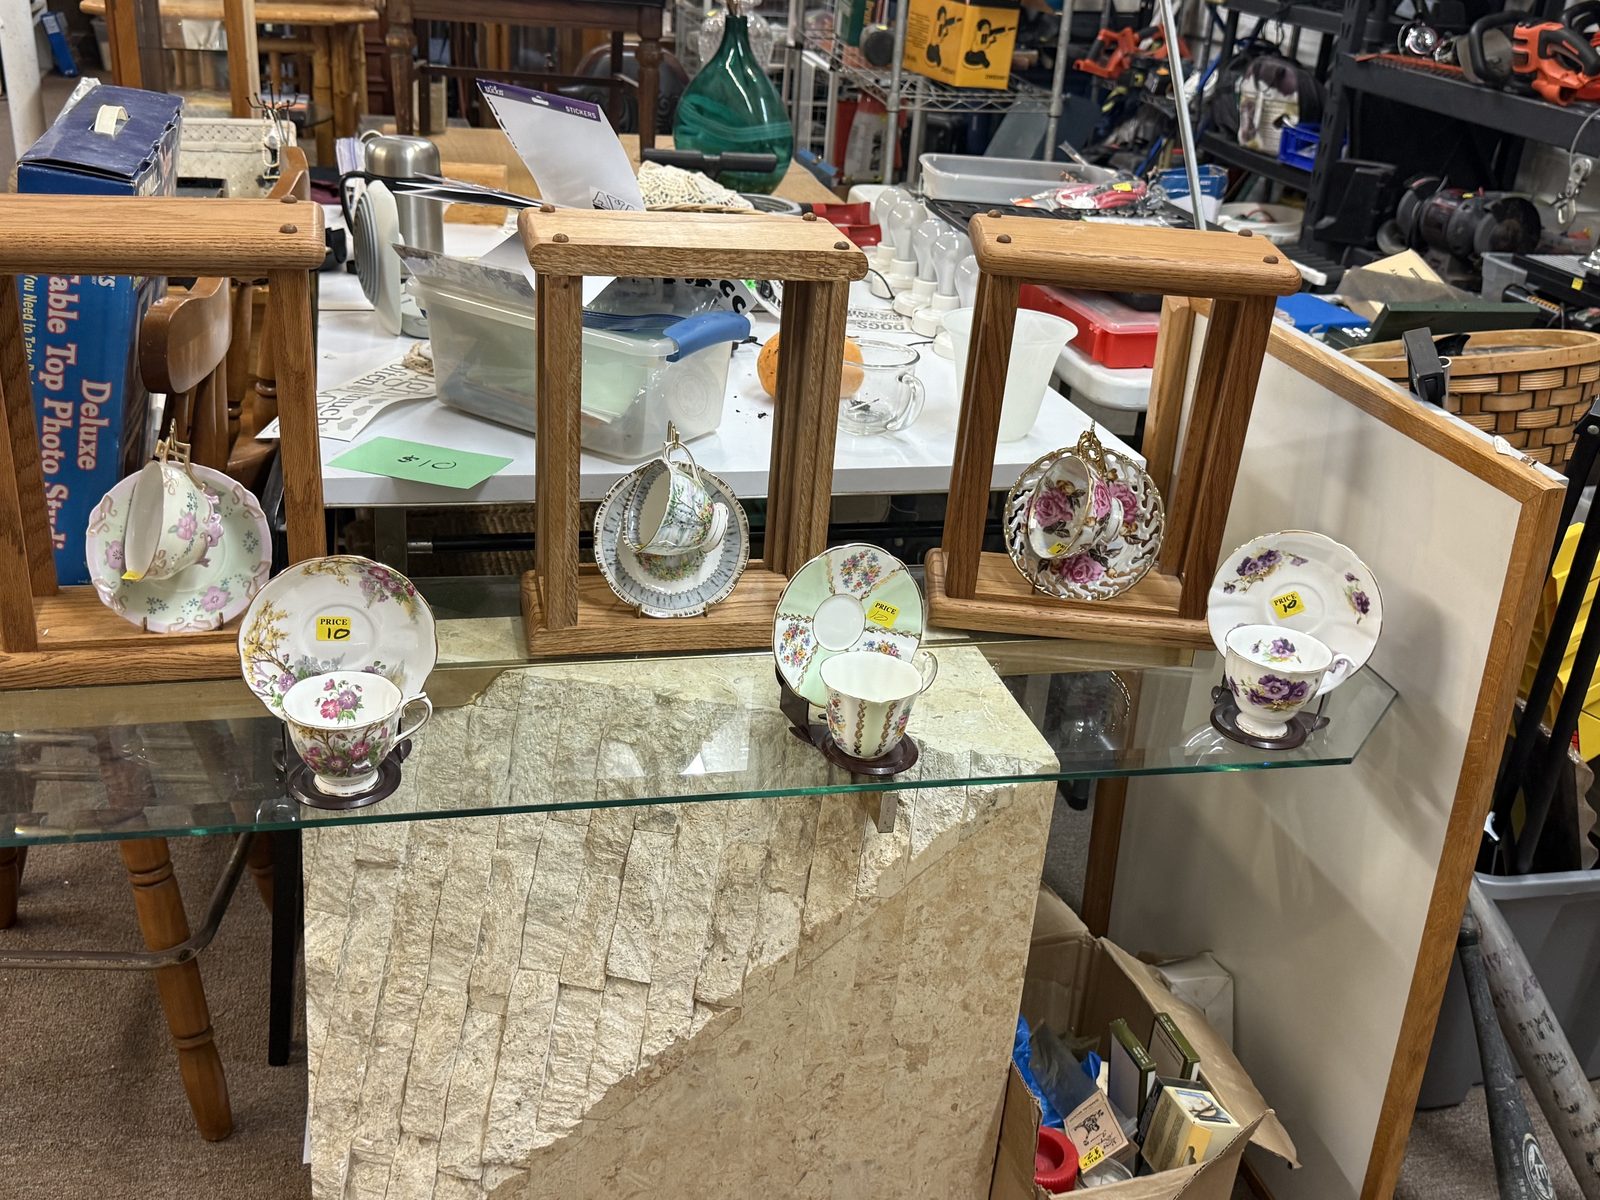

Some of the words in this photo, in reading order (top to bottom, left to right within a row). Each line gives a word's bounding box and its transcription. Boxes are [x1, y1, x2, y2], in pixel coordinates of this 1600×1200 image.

[565, 106, 597, 119] STICKERS
[22, 294, 38, 321] Need
[23, 322, 36, 334] to
[38, 343, 78, 391] Top
[353, 363, 408, 386] often
[77, 380, 112, 470] Deluxe
[42, 398, 74, 475] Photo
[397, 454, 457, 471] $10
[1274, 593, 1297, 606] PRICE
[1282, 599, 1298, 613] 10
[874, 602, 897, 615] PRICE
[320, 618, 348, 626] PRICE
[327, 627, 350, 639] 10
